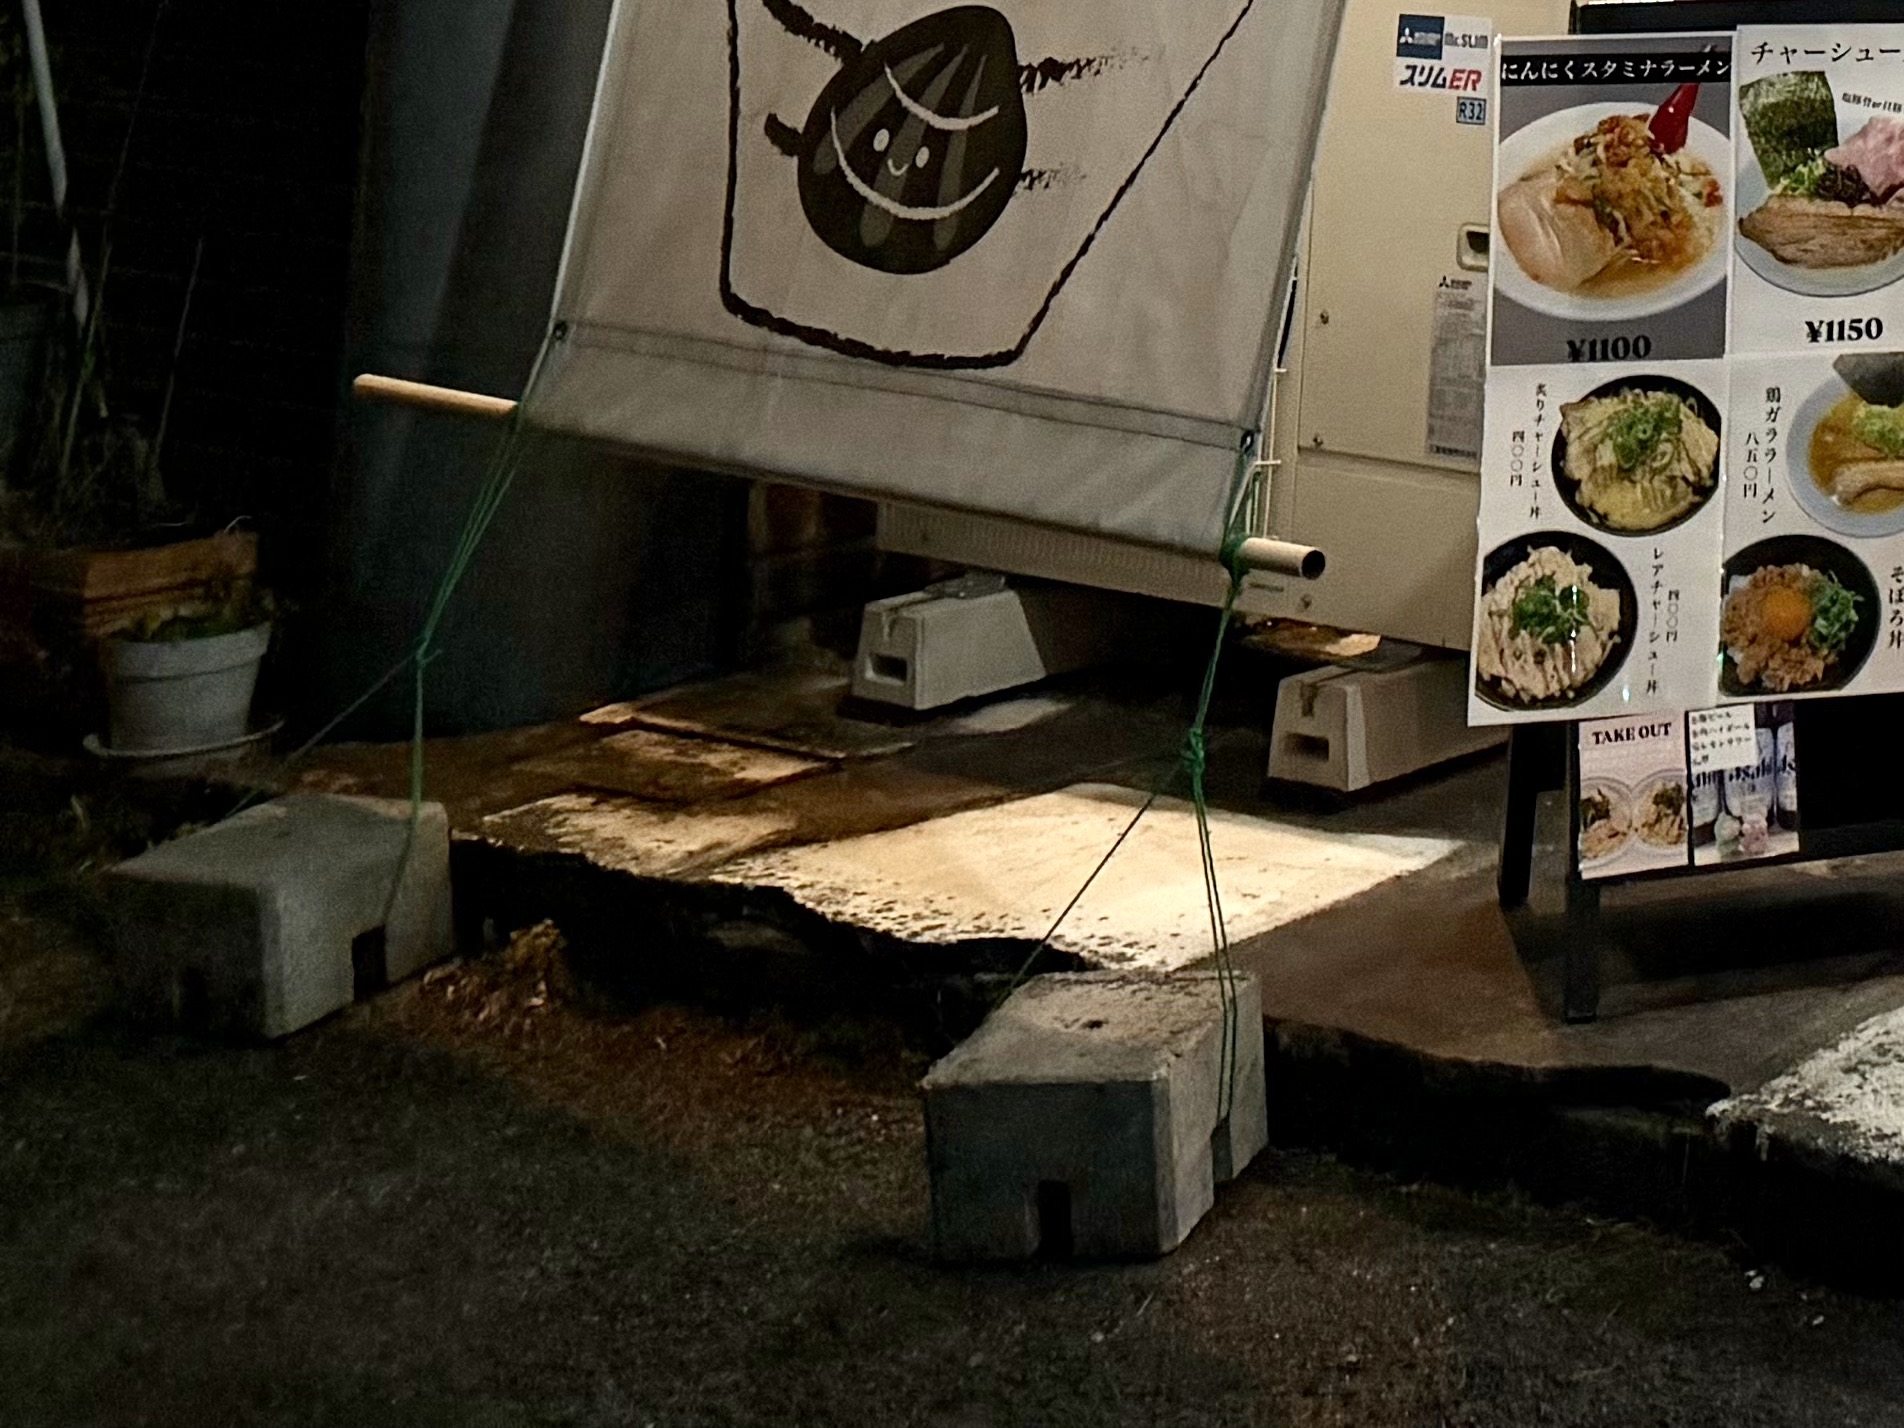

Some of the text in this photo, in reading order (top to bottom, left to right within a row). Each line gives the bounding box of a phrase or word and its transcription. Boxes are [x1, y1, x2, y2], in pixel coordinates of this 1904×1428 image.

[1501, 57, 1731, 82] にんにくスタミナラーメン
[1459, 101, 1484, 121] R32
[1805, 317, 1884, 344] ¥1150
[1566, 334, 1652, 363] ¥1100
[1592, 726, 1636, 745] TAKE
[1638, 722, 1673, 739] OUT
